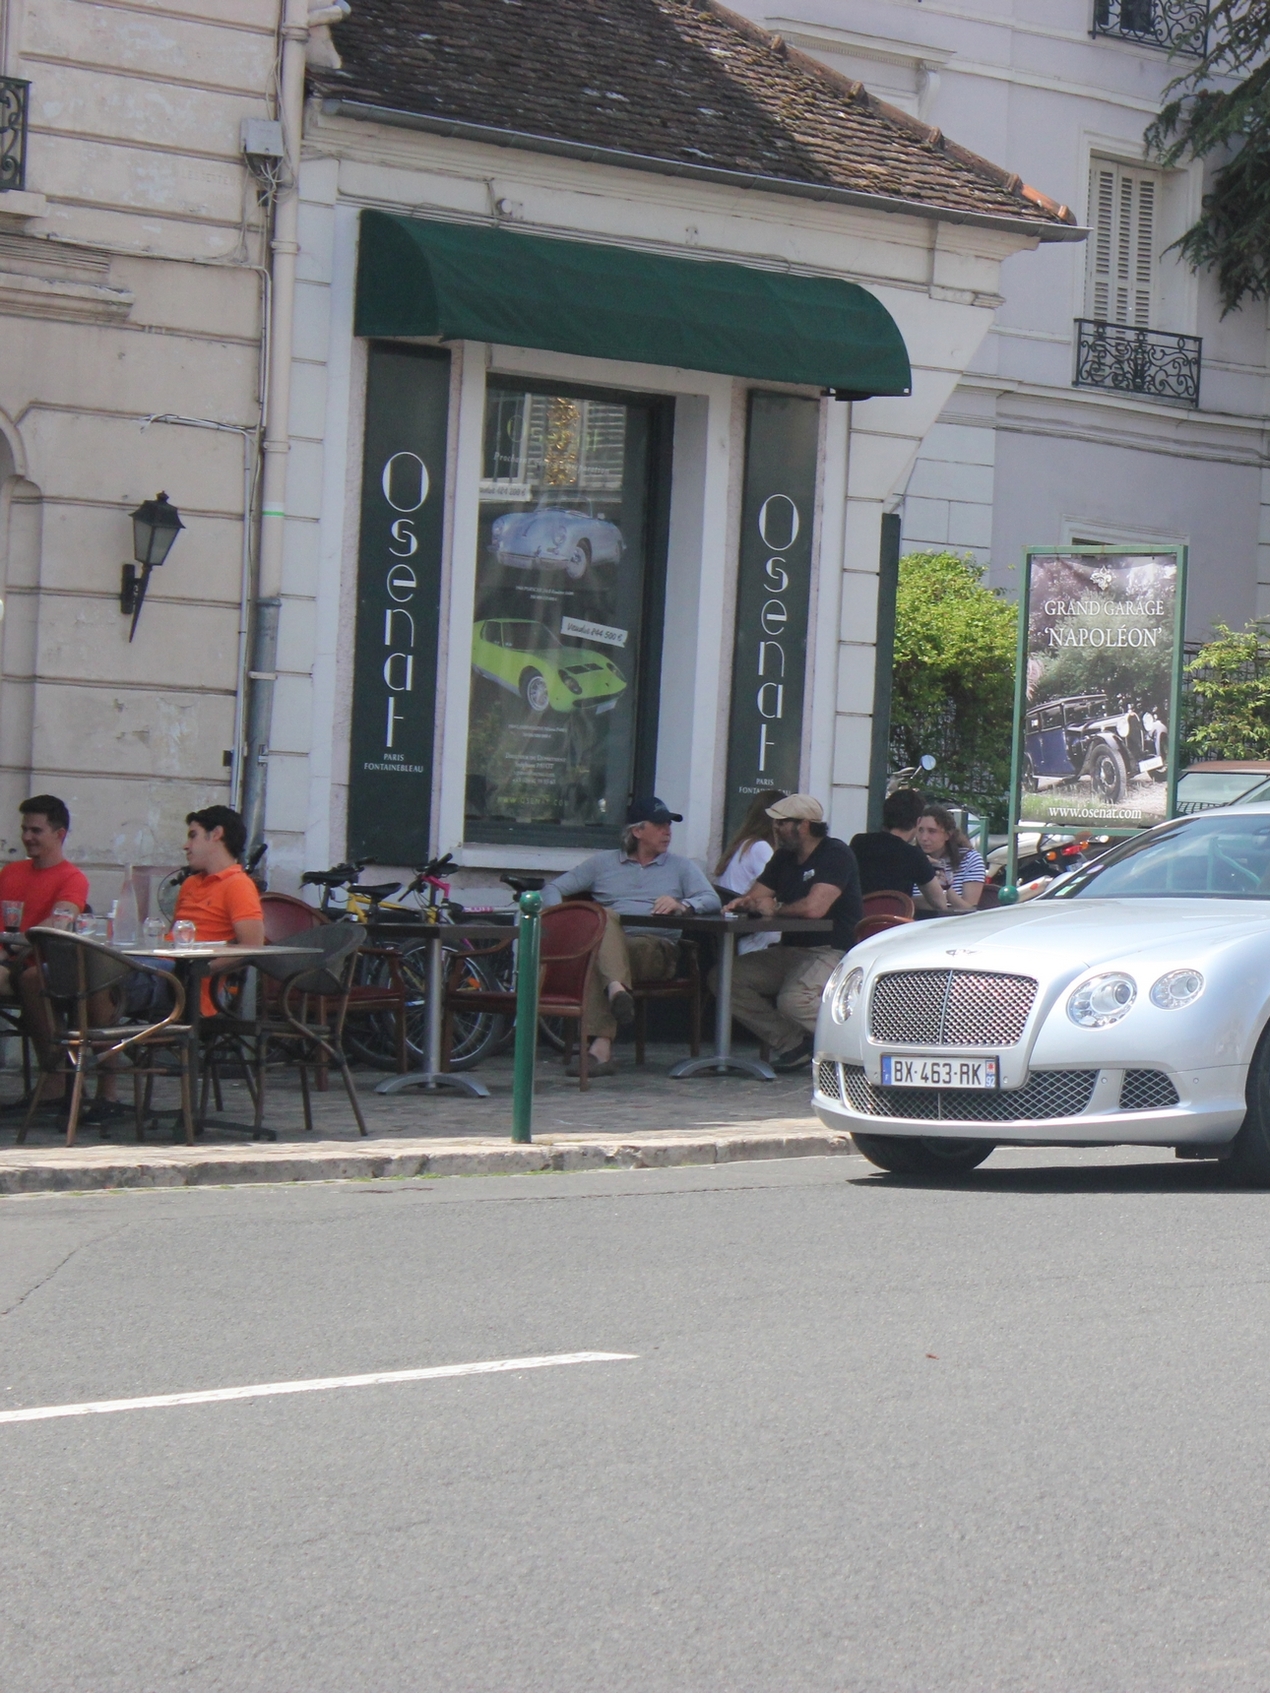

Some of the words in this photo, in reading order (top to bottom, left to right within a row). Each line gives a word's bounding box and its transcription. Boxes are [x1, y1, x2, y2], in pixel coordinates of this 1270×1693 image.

[381, 451, 430, 748] Osenat
[1044, 600, 1101, 616] GRAND
[1103, 600, 1165, 616] GARAGE
[756, 493, 800, 772] Osenat
[383, 753, 405, 762] PARIS
[364, 762, 424, 774] FONTAINEBLEAU
[756, 777, 775, 786] PARIS
[1048, 805, 1142, 820] www.osenat.com
[894, 1060, 982, 1085] BX-463-RK
